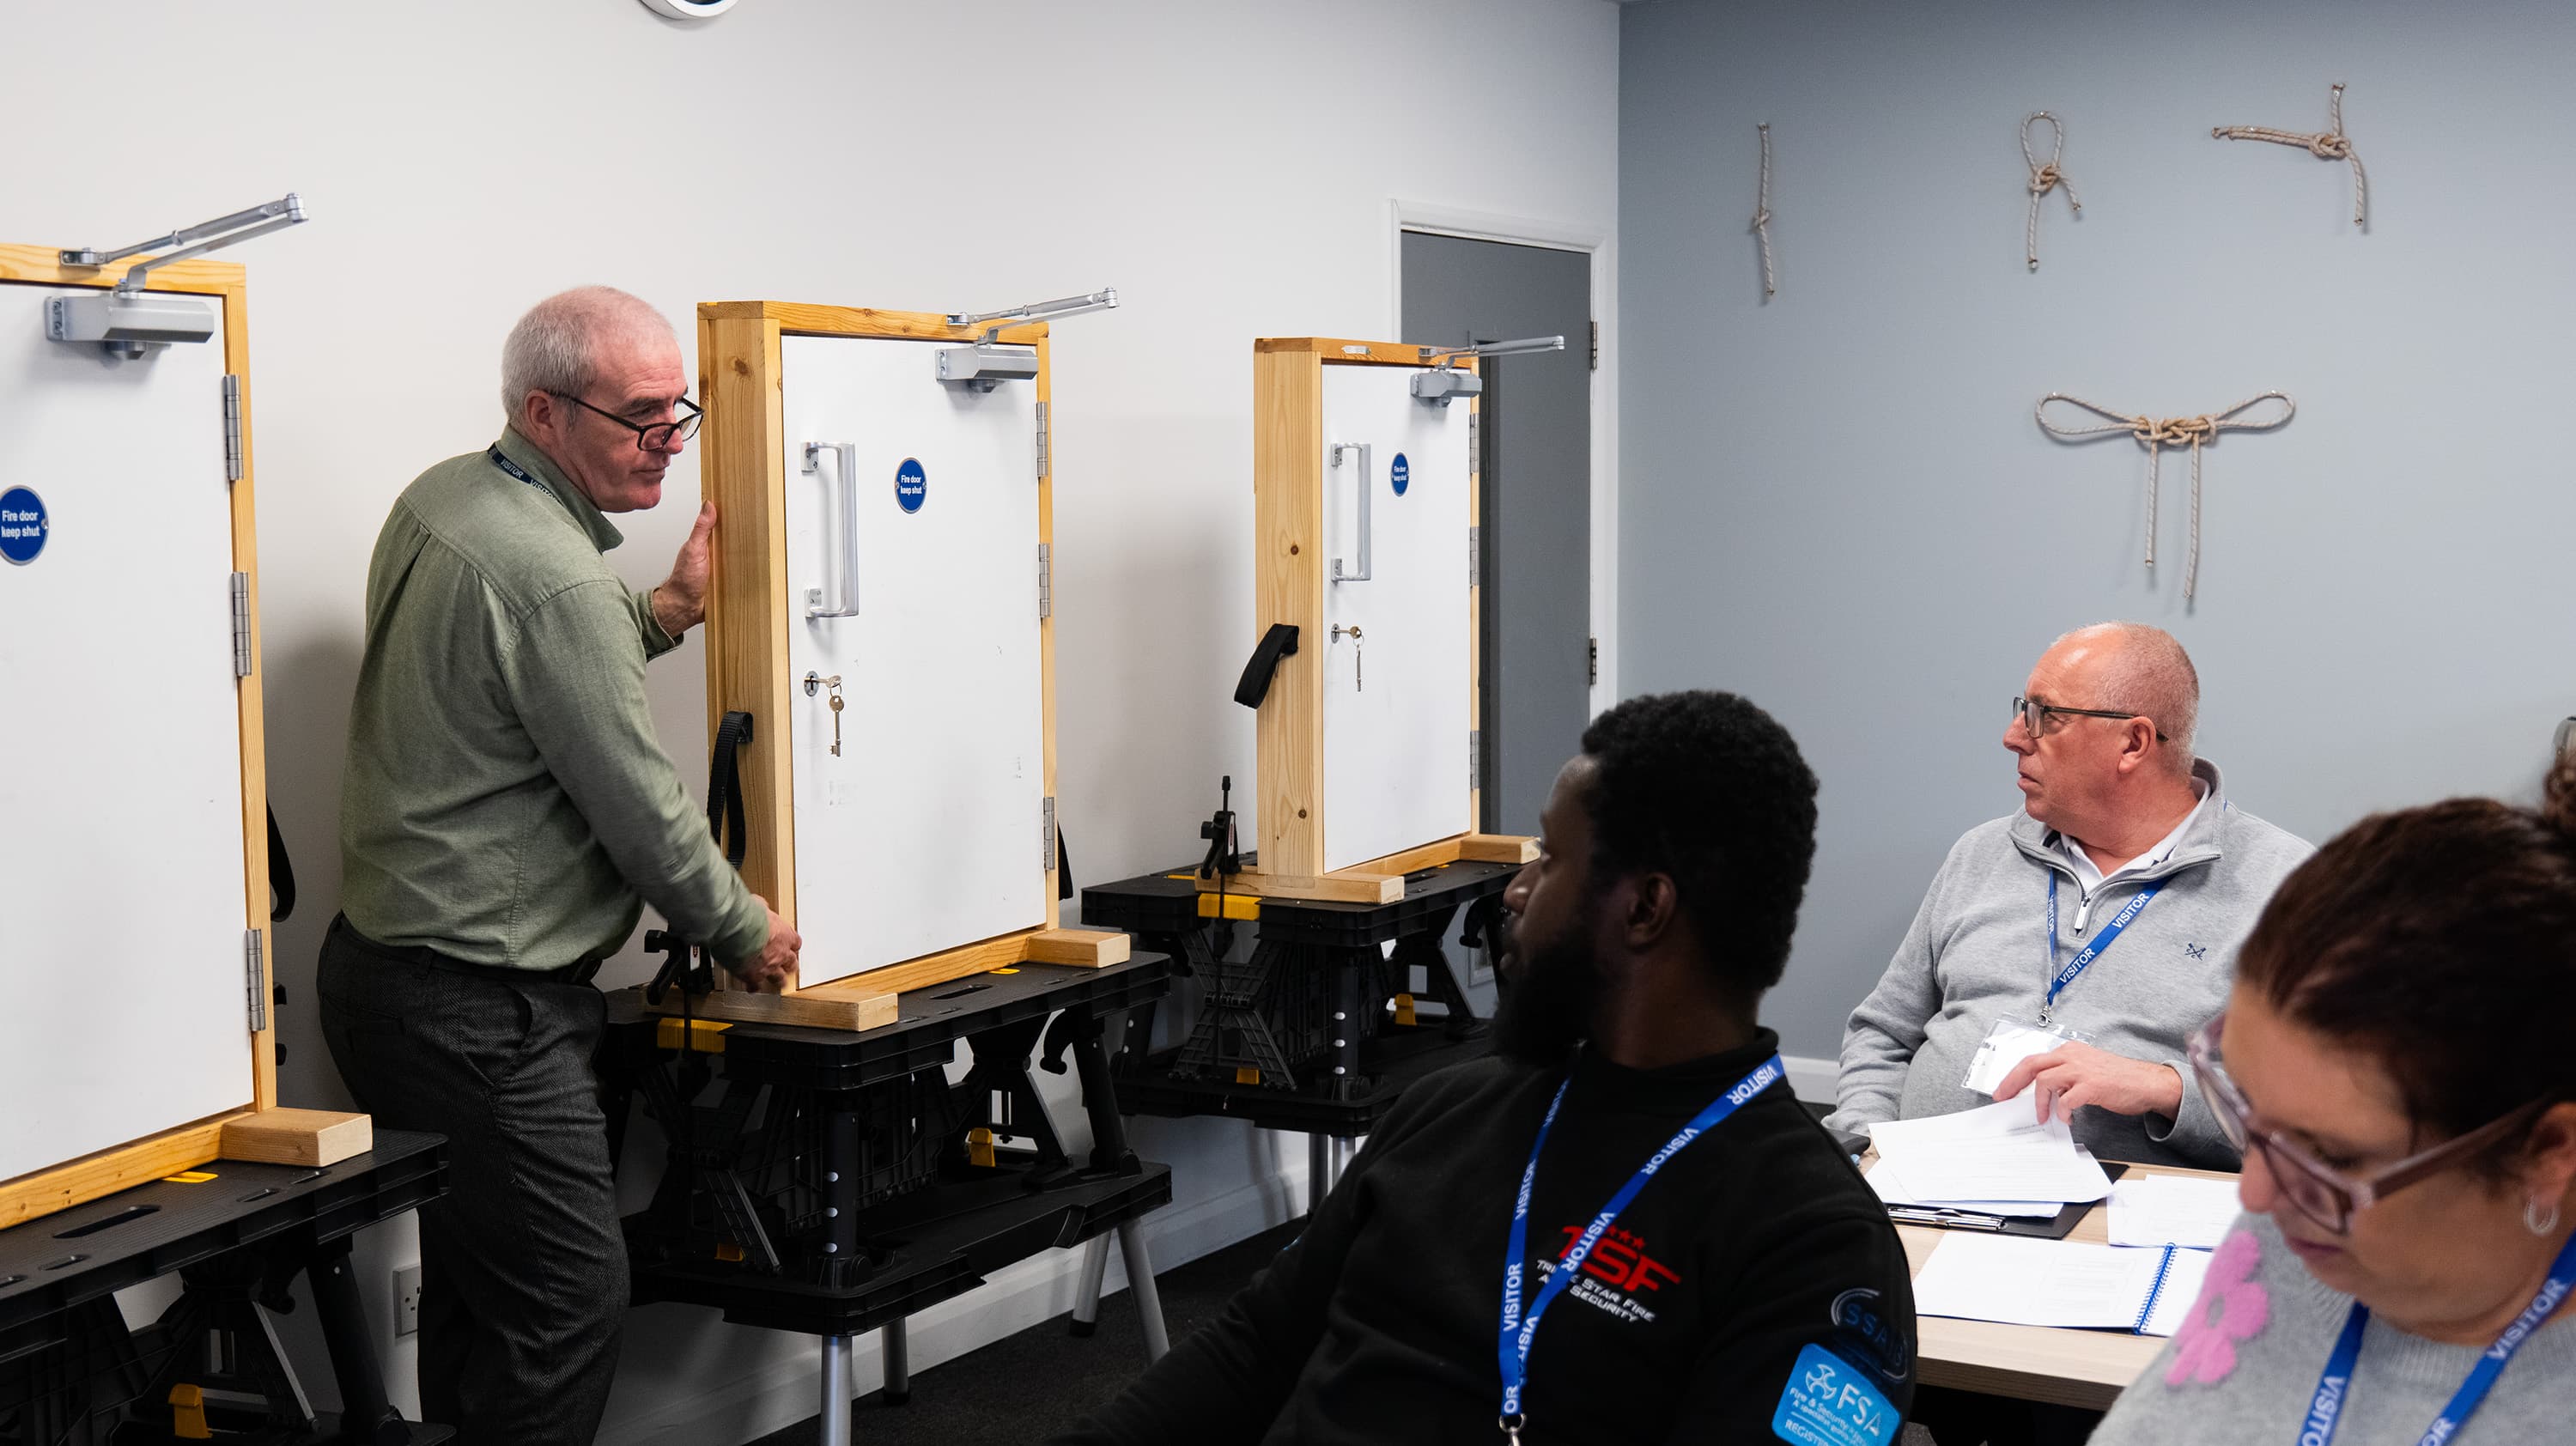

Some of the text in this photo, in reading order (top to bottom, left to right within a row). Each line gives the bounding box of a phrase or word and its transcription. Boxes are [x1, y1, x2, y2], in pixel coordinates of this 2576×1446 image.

[501, 459, 524, 478] VISITOR
[901, 475, 921, 483] Fire door
[1, 526, 40, 539] keep shut
[2, 510, 39, 522] Fire door
[2111, 892, 2149, 928] VISITOR
[2059, 947, 2096, 984] VISITOR
[1725, 1064, 1777, 1105] VISITOR
[1640, 1127, 1700, 1176] VISITOR
[1514, 1158, 1538, 1221] VISITOR
[1561, 1212, 1615, 1273] VISITOR
[1503, 1262, 1522, 1332] VISITOR
[1569, 1285, 1638, 1322] SECURITY
[1582, 1278, 1622, 1303] STAR
[1623, 1298, 1656, 1323] FIRE
[2486, 1278, 2569, 1360] VISITOR
[1837, 1383, 1881, 1437] FSA
[2300, 1376, 2346, 1446] VISITO
